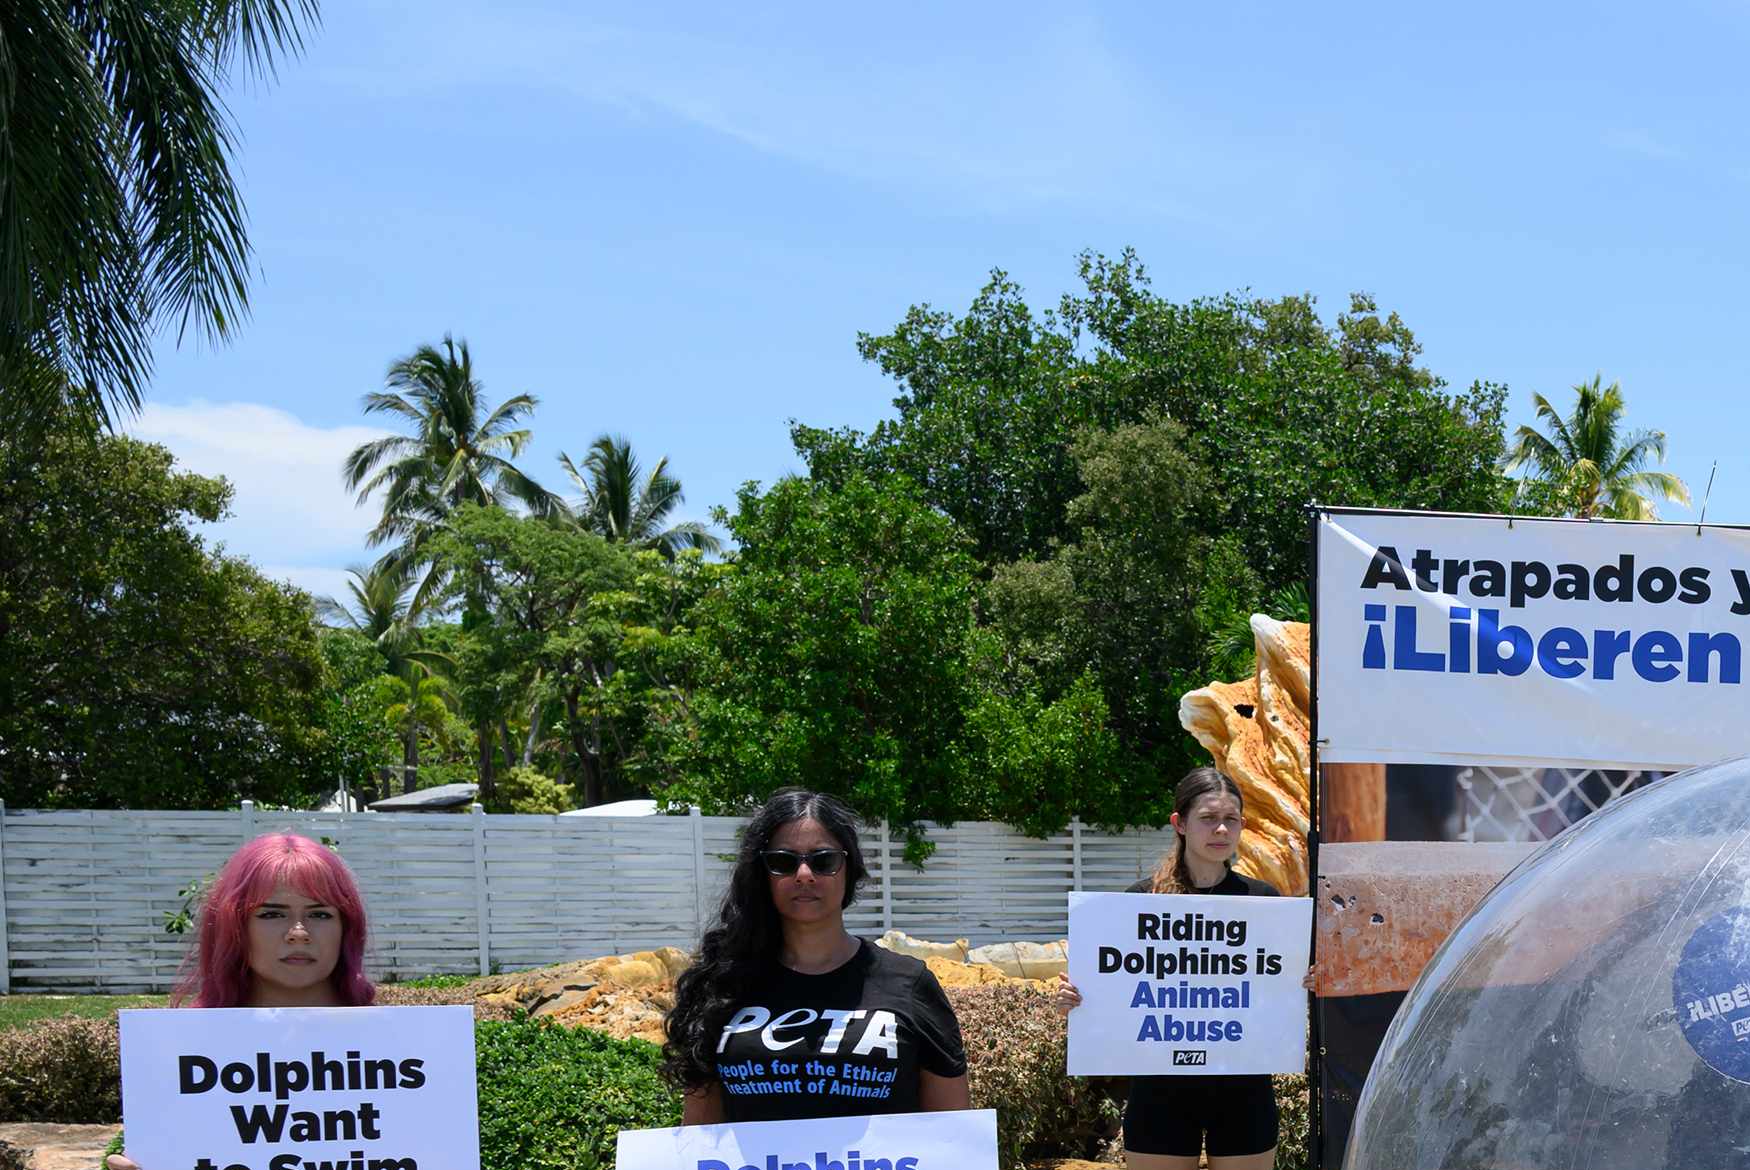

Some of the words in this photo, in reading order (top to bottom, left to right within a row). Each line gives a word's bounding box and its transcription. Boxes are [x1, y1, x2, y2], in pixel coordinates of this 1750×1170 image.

[1360, 546, 1711, 608] Atrapados
[1363, 604, 1741, 684] ¡Liberen
[1138, 913, 1246, 946] Riding
[1099, 947, 1247, 979] Dolphins
[1256, 948, 1282, 975] is
[1130, 981, 1249, 1008] Animal
[1137, 1015, 1242, 1041] Abuse
[179, 1052, 425, 1100] Dolphins
[717, 1060, 765, 1081] People
[771, 1059, 799, 1076] for
[806, 1061, 836, 1077] the
[843, 1064, 898, 1083] Ethical
[808, 1080, 824, 1094] of
[830, 1081, 891, 1099] Animals
[230, 1103, 380, 1143] Want
